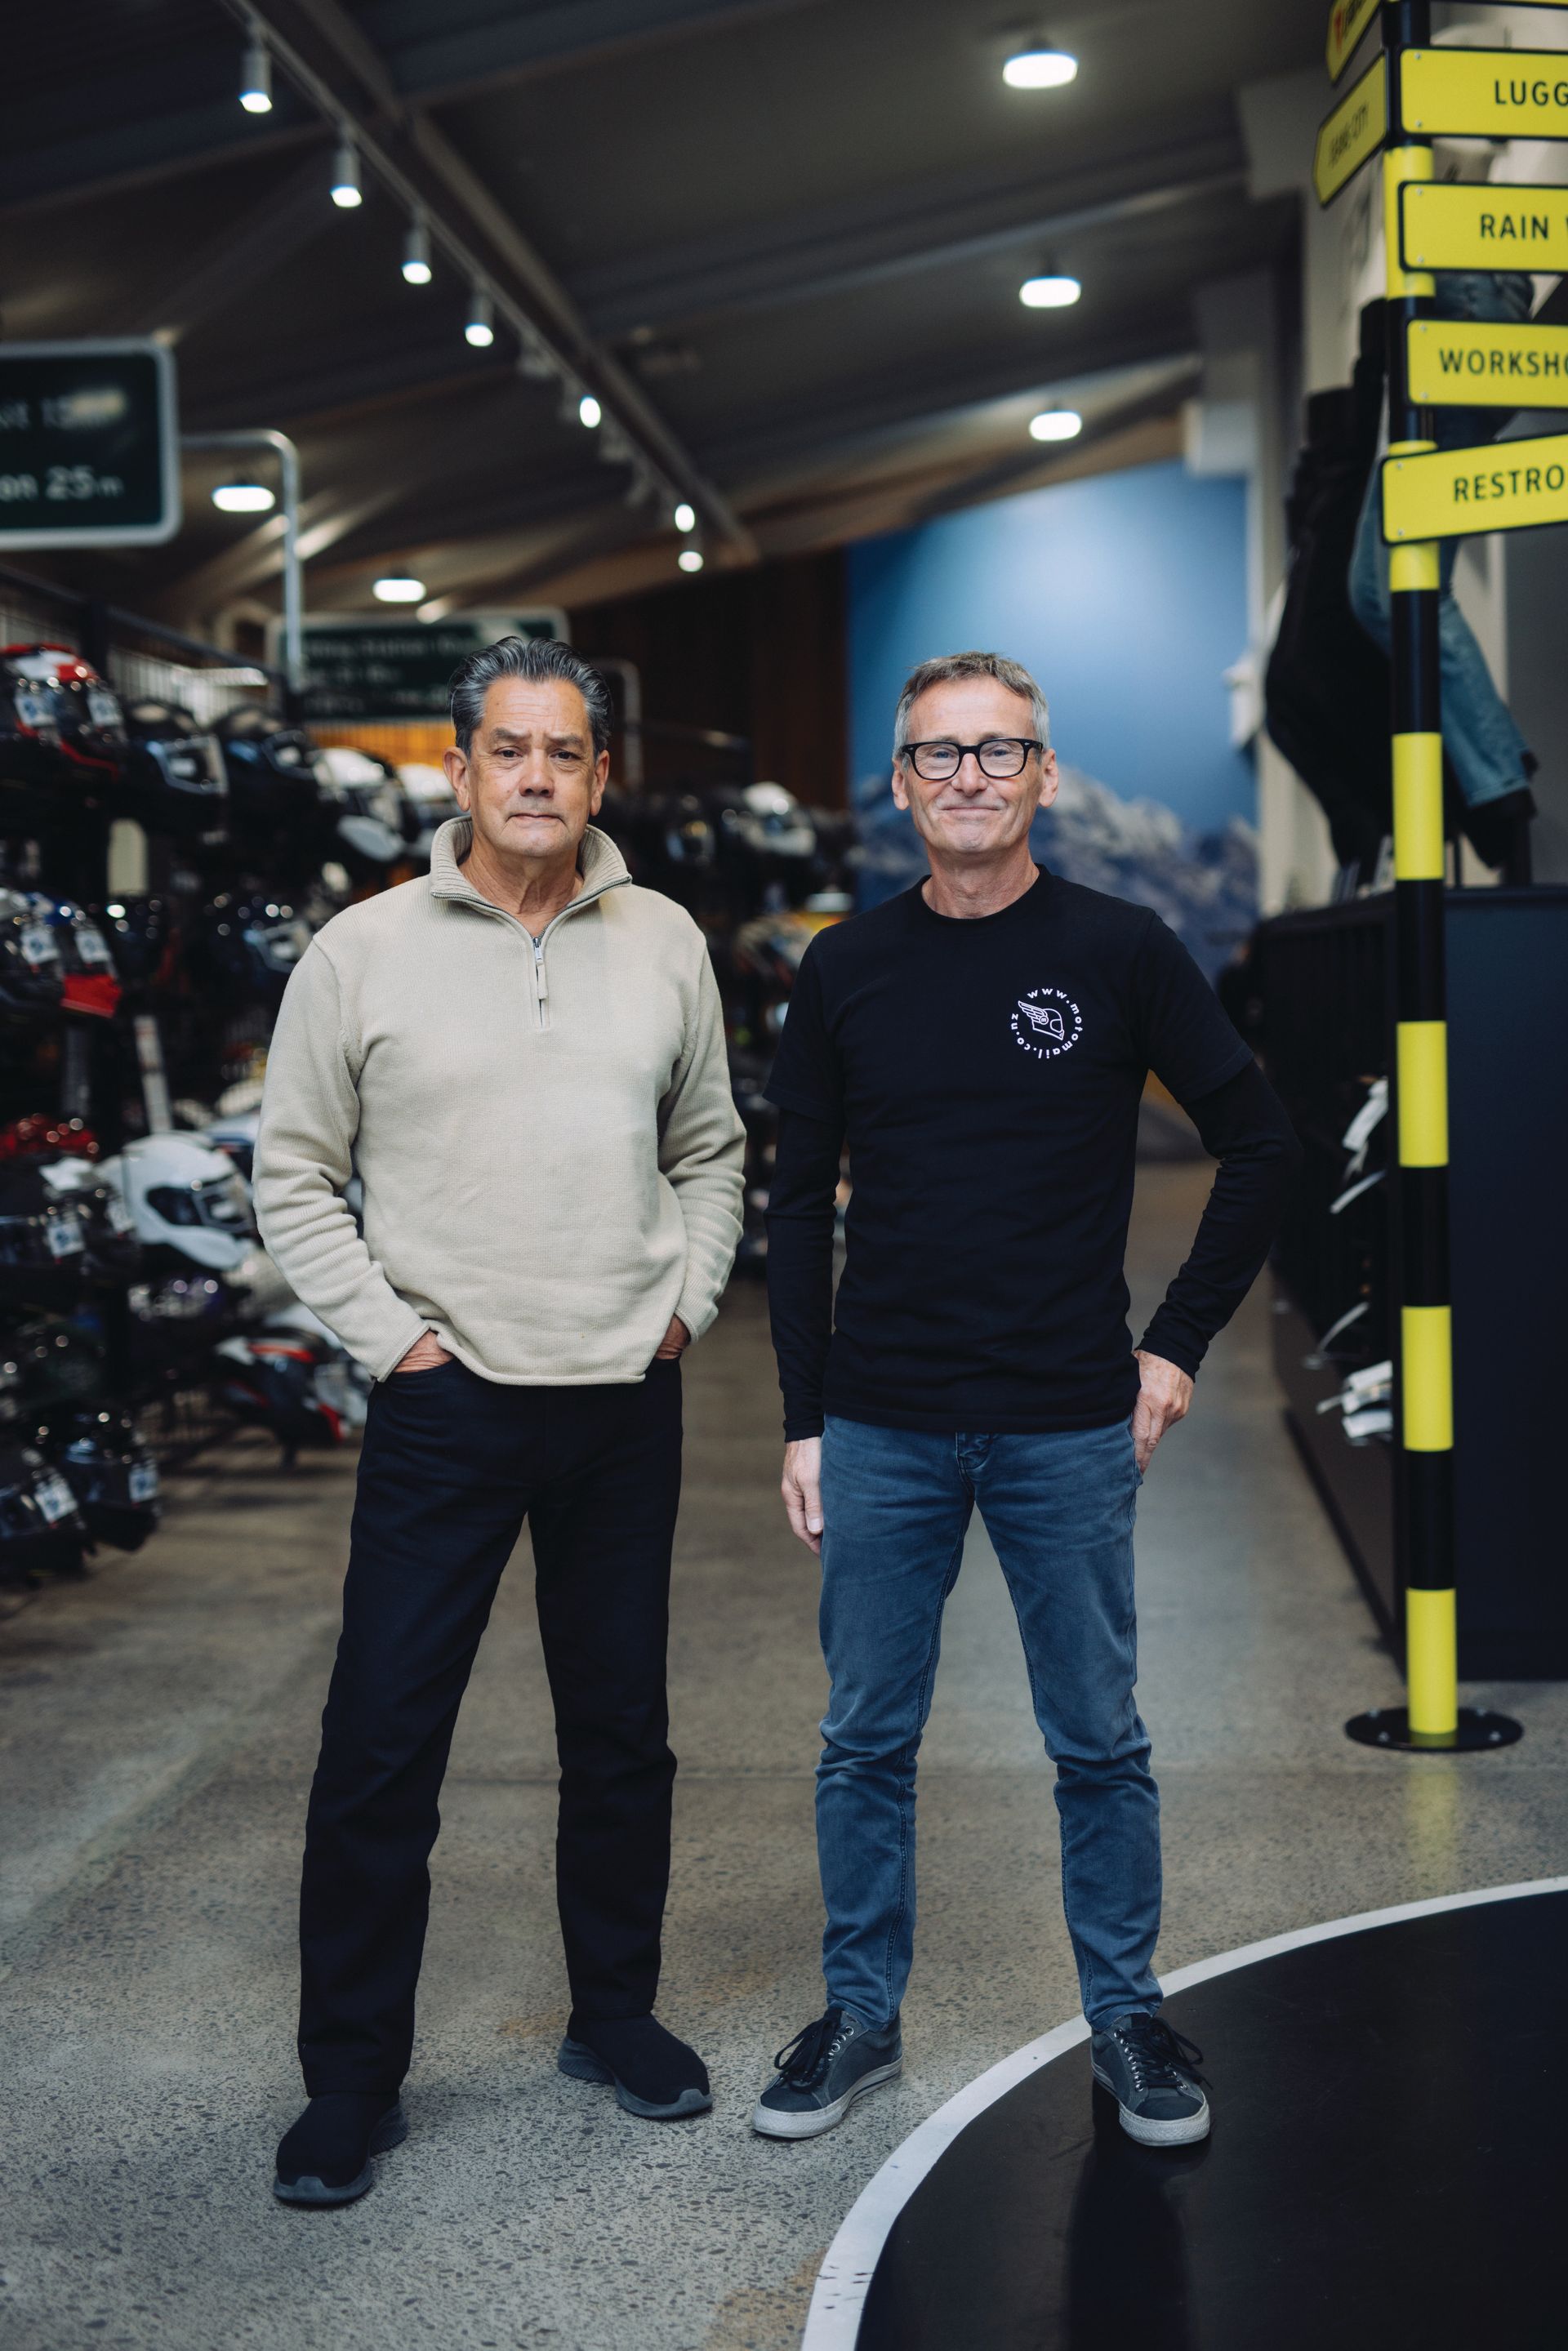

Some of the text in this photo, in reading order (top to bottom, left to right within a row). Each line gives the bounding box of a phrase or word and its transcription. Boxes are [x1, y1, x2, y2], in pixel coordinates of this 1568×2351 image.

[1494, 79, 1568, 106] LUGG
[1480, 213, 1548, 239] RAIN
[1439, 348, 1568, 376] WORKSH
[1454, 465, 1565, 502] RESTRO
